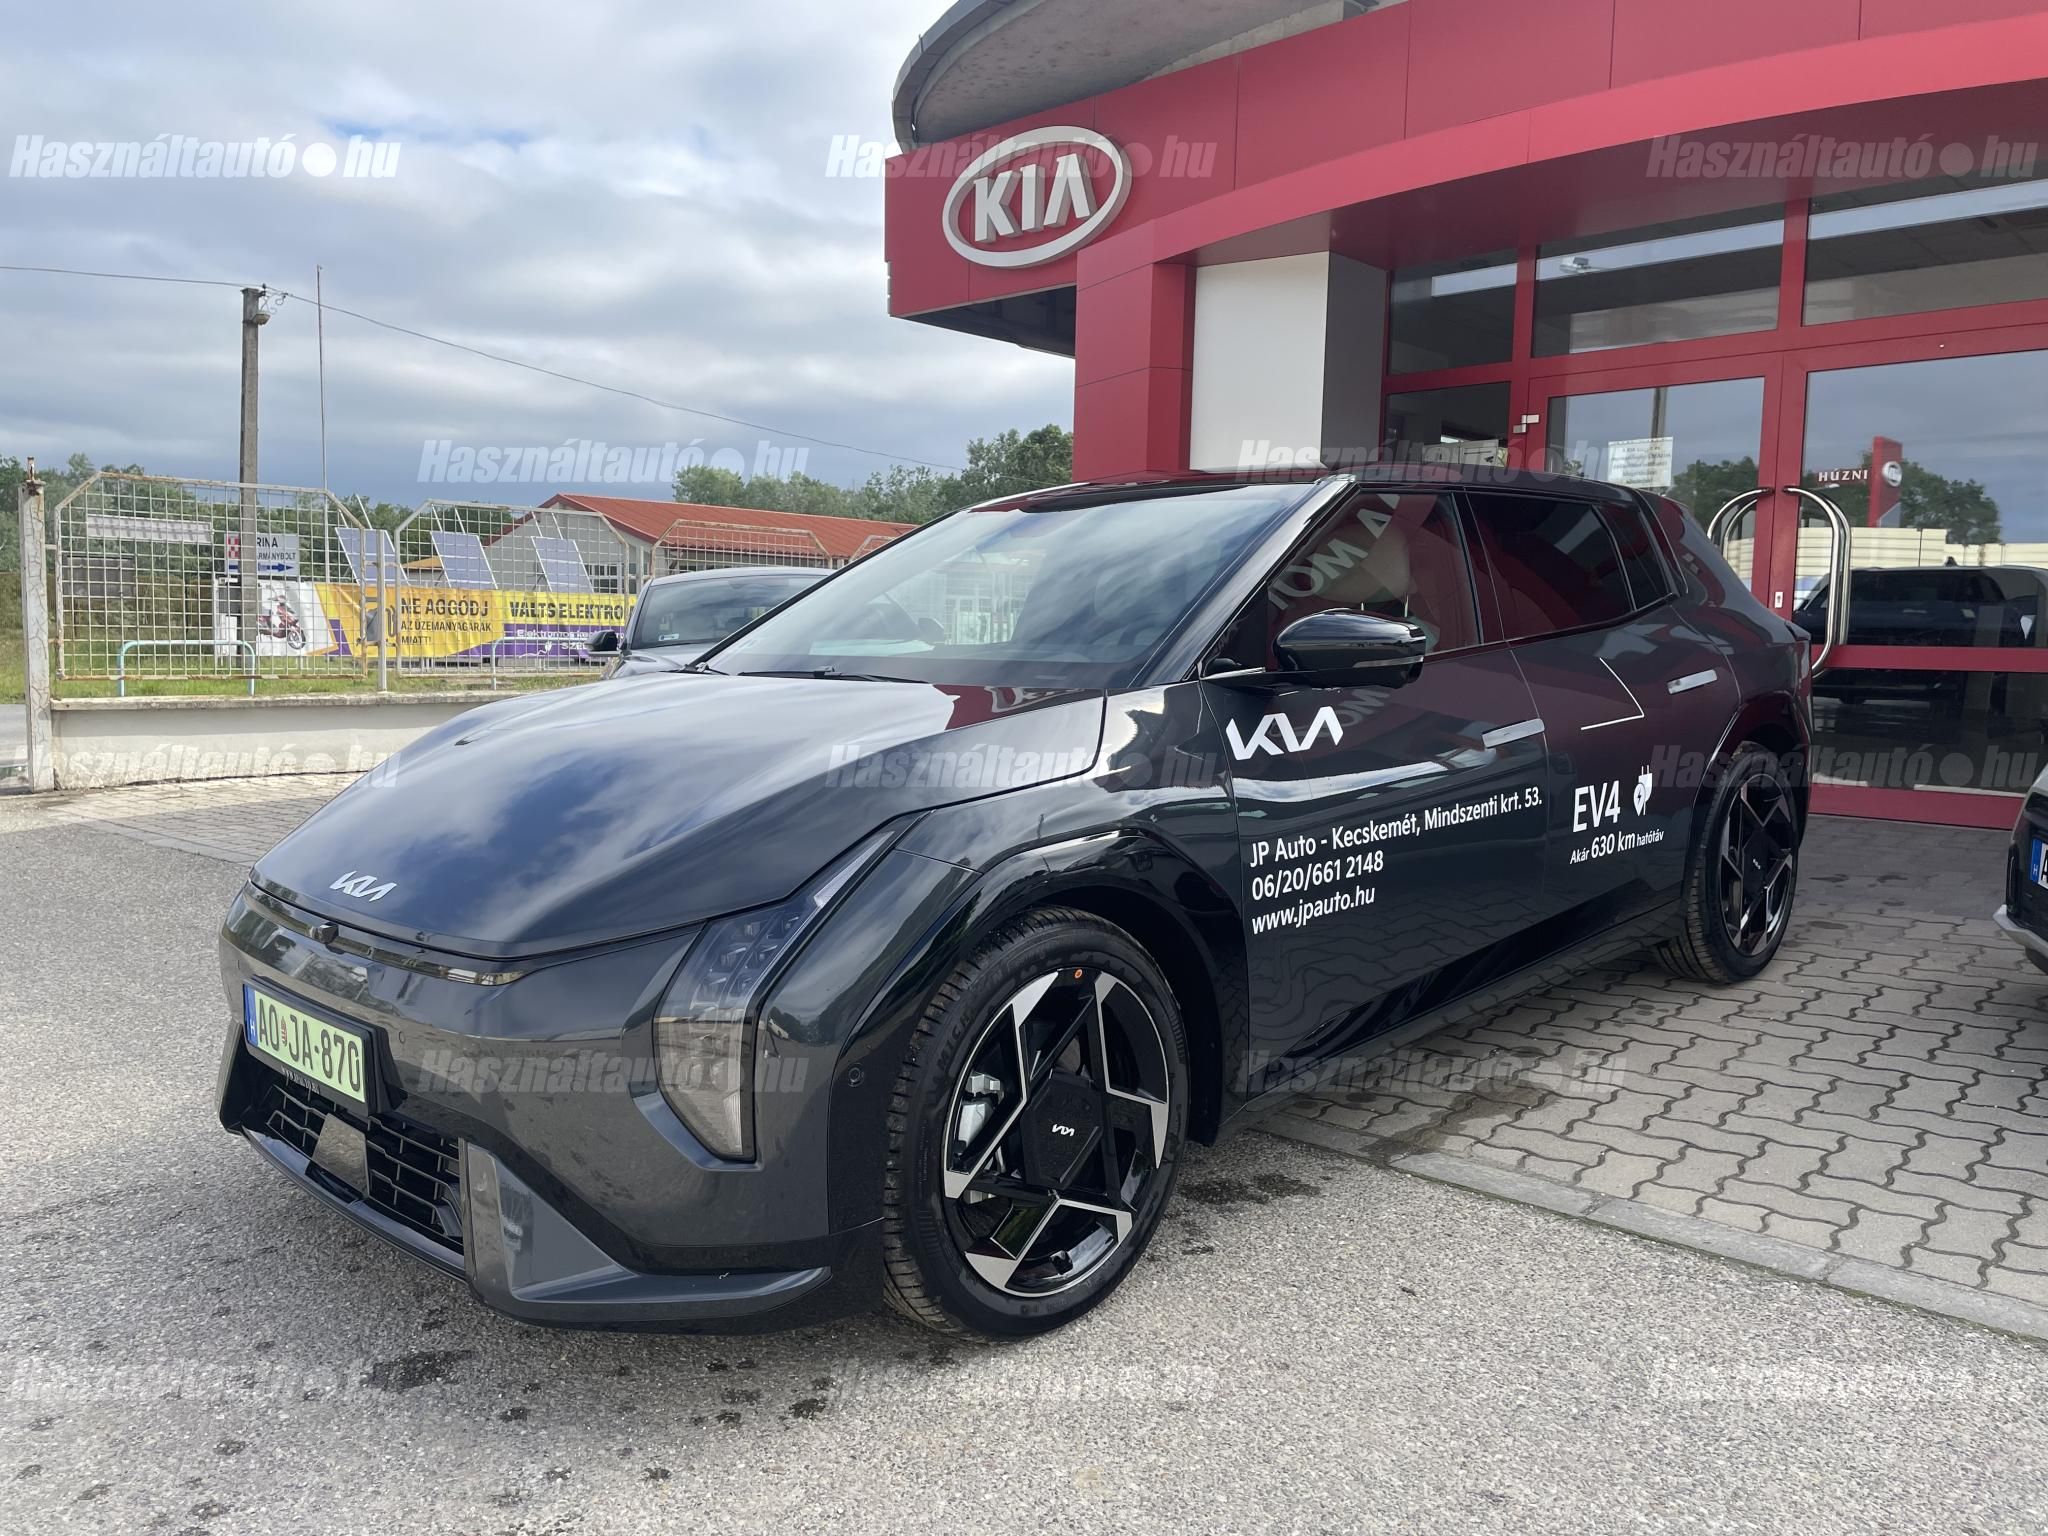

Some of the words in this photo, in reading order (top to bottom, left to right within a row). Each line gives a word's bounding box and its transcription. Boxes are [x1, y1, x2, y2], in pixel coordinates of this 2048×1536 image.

[973, 153, 1093, 243] KIA
[1818, 467, 1868, 482] HÚZNI
[257, 536, 278, 548] RINA
[401, 597, 421, 615] NE
[425, 595, 488, 617] AGGÓDJ
[1226, 706, 1344, 761] KIA
[1250, 841, 1270, 868] JP
[1275, 835, 1316, 862] Auto
[1332, 813, 1420, 850] Kecskemét,
[1424, 795, 1498, 831] Mindszenti
[1500, 792, 1522, 814] krt.
[1525, 786, 1543, 808] 53.
[1573, 780, 1620, 832] EV4
[1569, 847, 1590, 864] Akár
[1591, 833, 1615, 859] 630
[1617, 831, 1636, 852] km
[1636, 828, 1665, 847] hatótáv
[330, 870, 397, 901] KIA
[1252, 859, 1341, 901] 06/20/661
[1346, 850, 1384, 878] 2148
[1252, 885, 1376, 934] www.jpauto.hu
